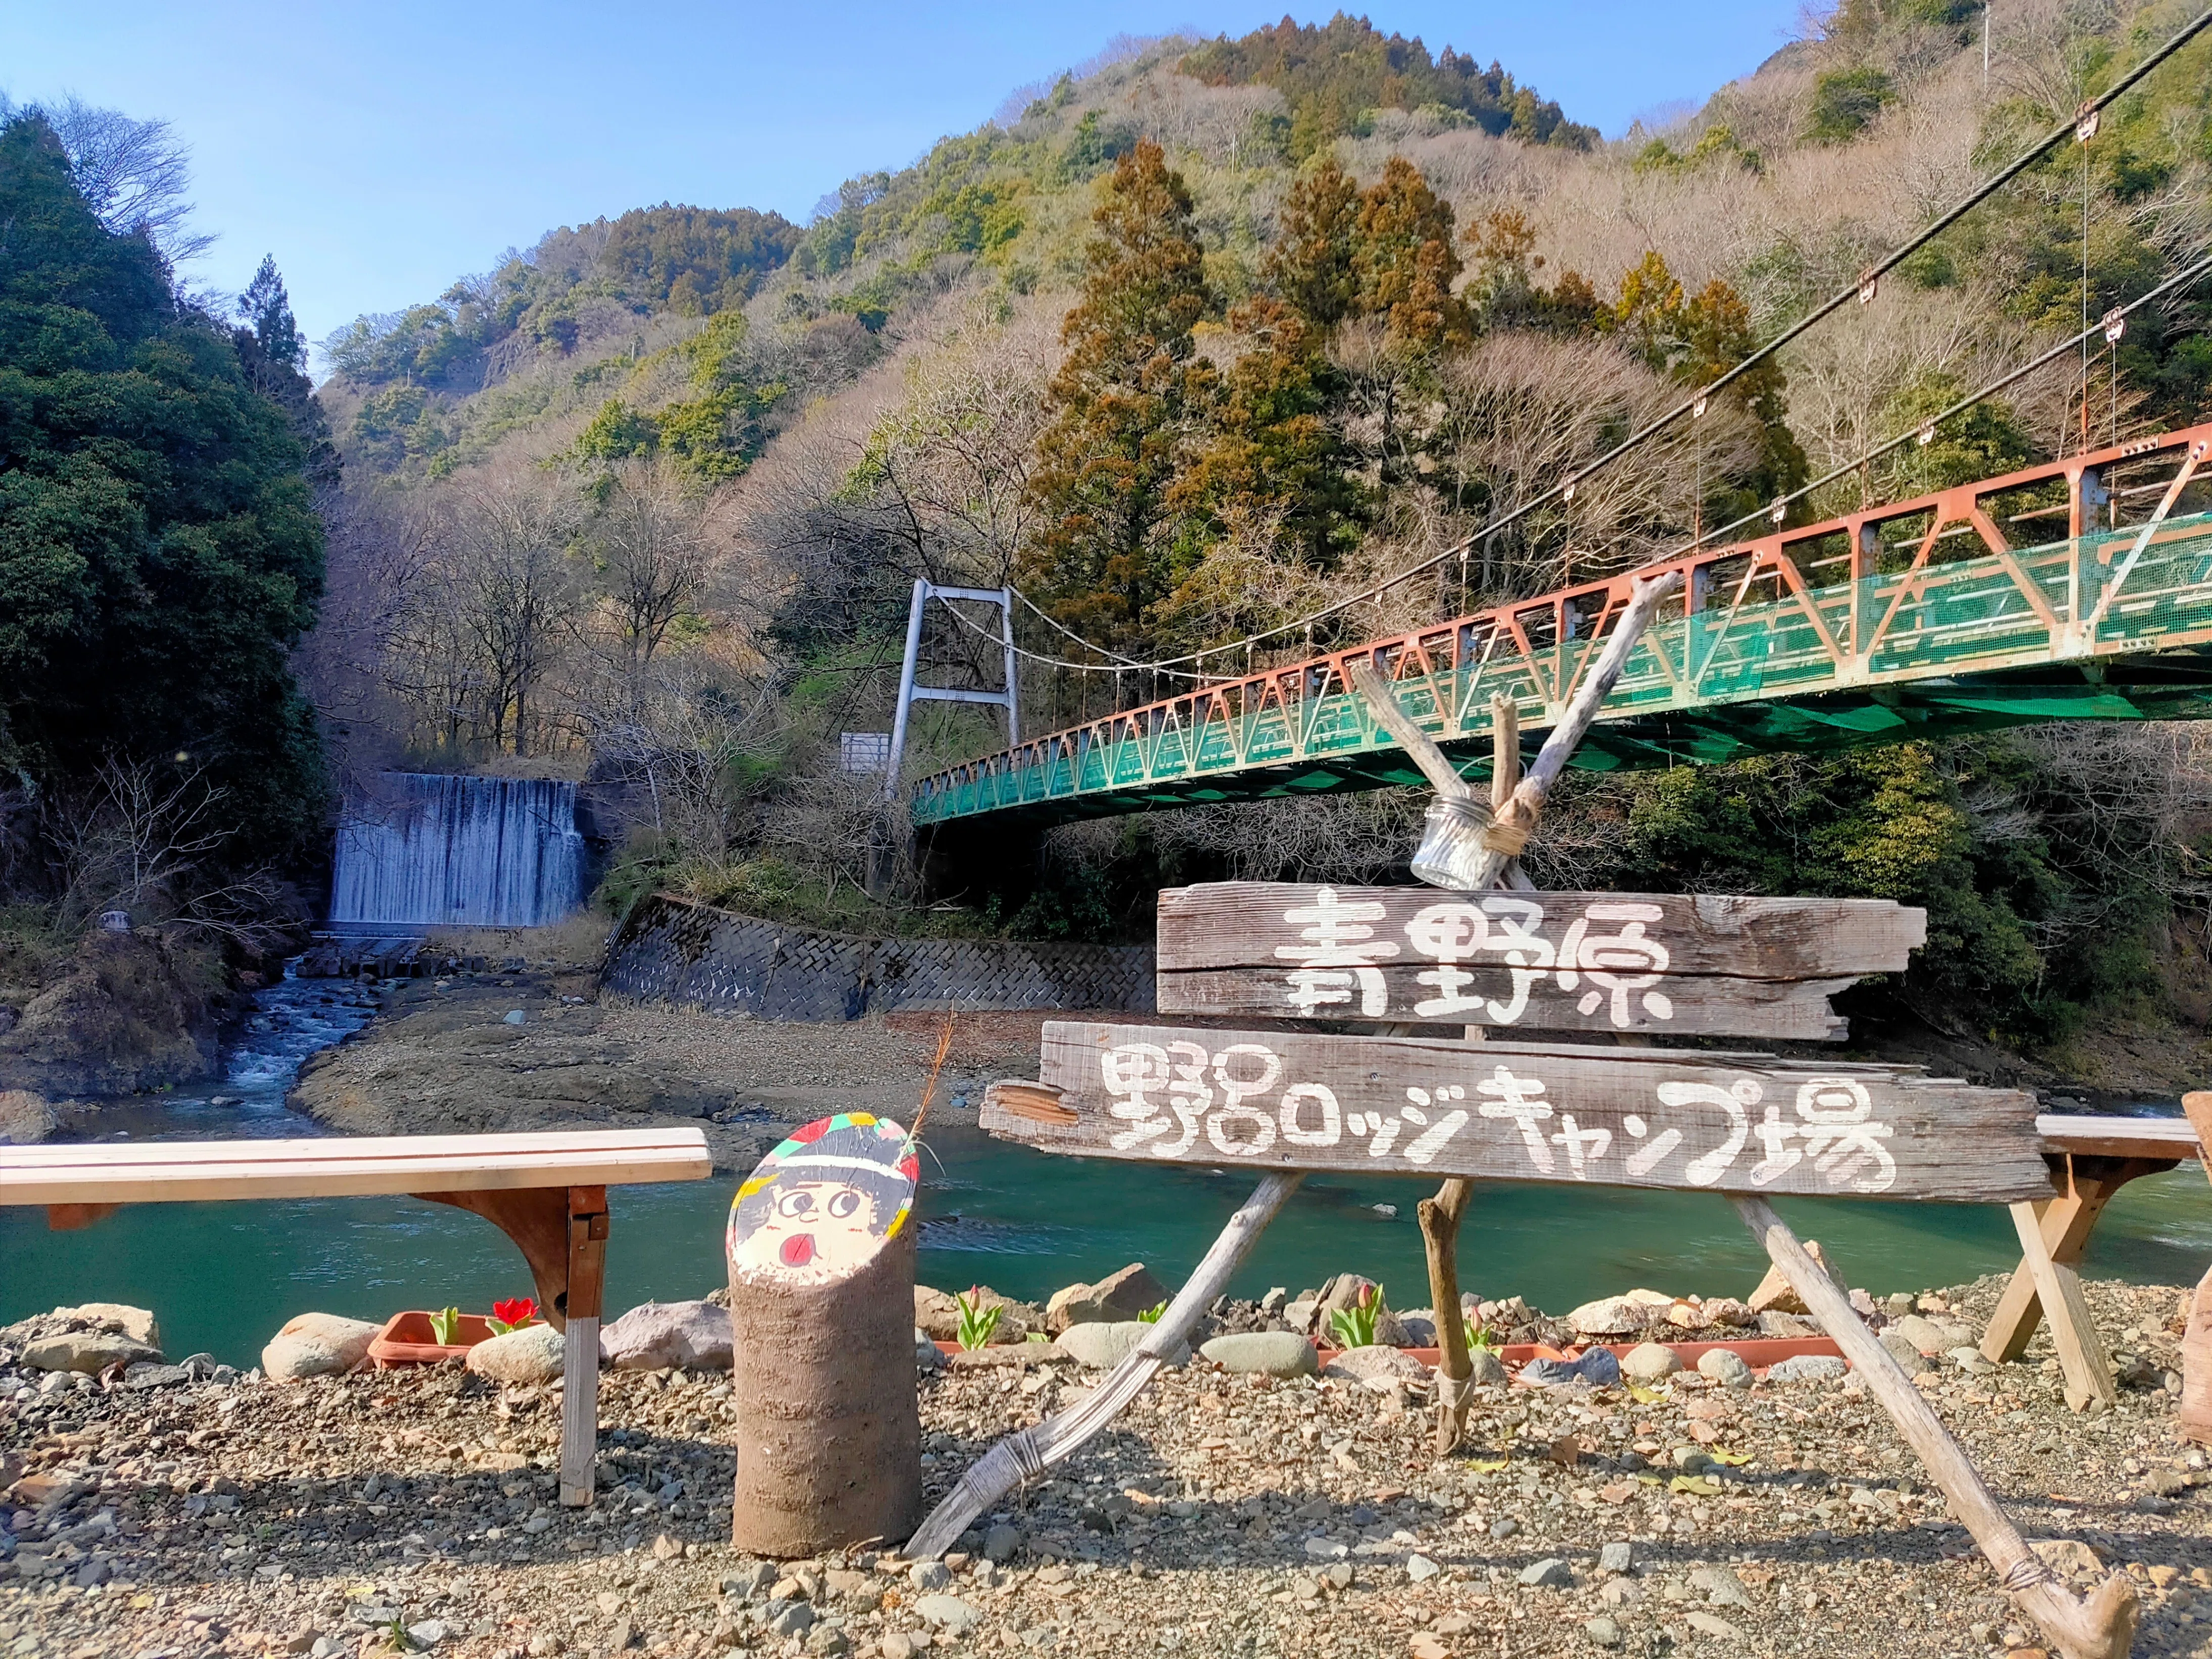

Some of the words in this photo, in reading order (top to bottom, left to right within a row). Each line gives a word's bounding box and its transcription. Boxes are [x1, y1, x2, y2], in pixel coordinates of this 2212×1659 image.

[1274, 886, 1673, 1027] 青野原
[1101, 1040, 1896, 1192] 野呂ロッジキャンプ場
